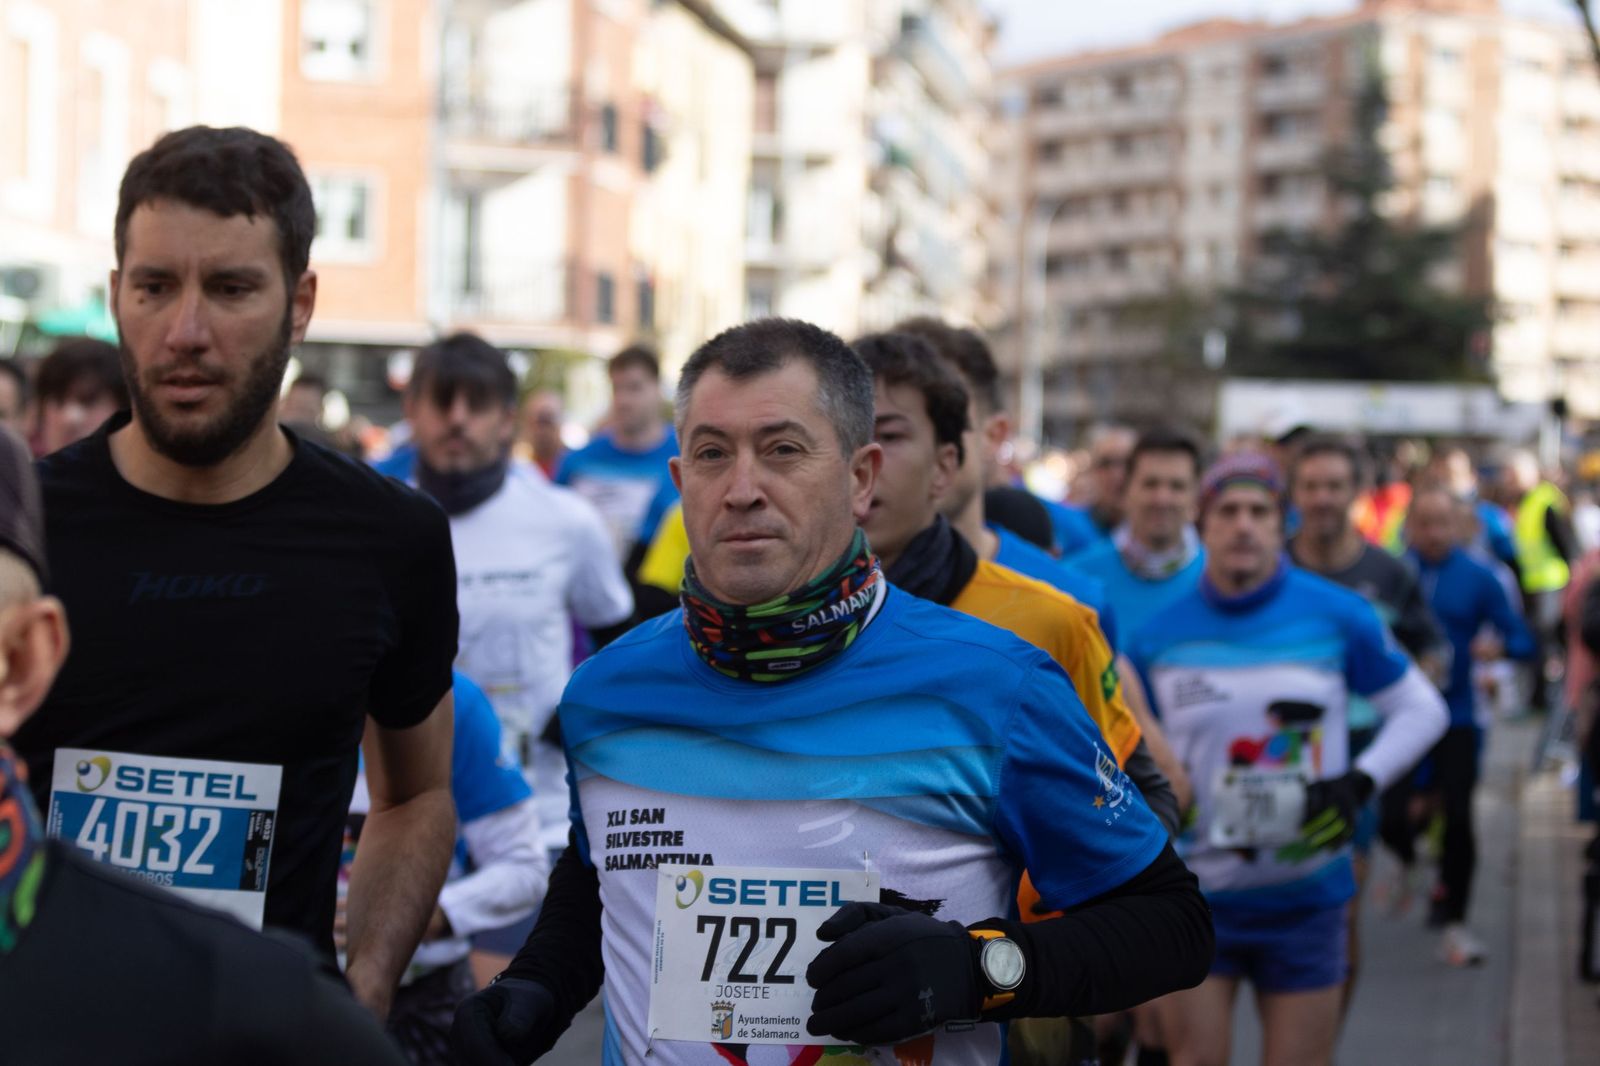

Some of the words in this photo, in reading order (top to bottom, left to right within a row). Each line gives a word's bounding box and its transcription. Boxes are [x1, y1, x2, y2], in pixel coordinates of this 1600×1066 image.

[115, 765, 257, 801] SETEL
[606, 810, 627, 828] XLI
[630, 808, 665, 825] SAN
[76, 798, 222, 875] 4032
[605, 830, 684, 850] SILVESTRE
[605, 853, 714, 872] SALMANTINA
[708, 877, 856, 907] SETEL
[697, 915, 797, 984] 722
[716, 985, 770, 999] JOSETE
[737, 1014, 801, 1026] Ayuntamiento
[737, 1028, 748, 1038] de
[751, 1028, 800, 1039] Salamanca
